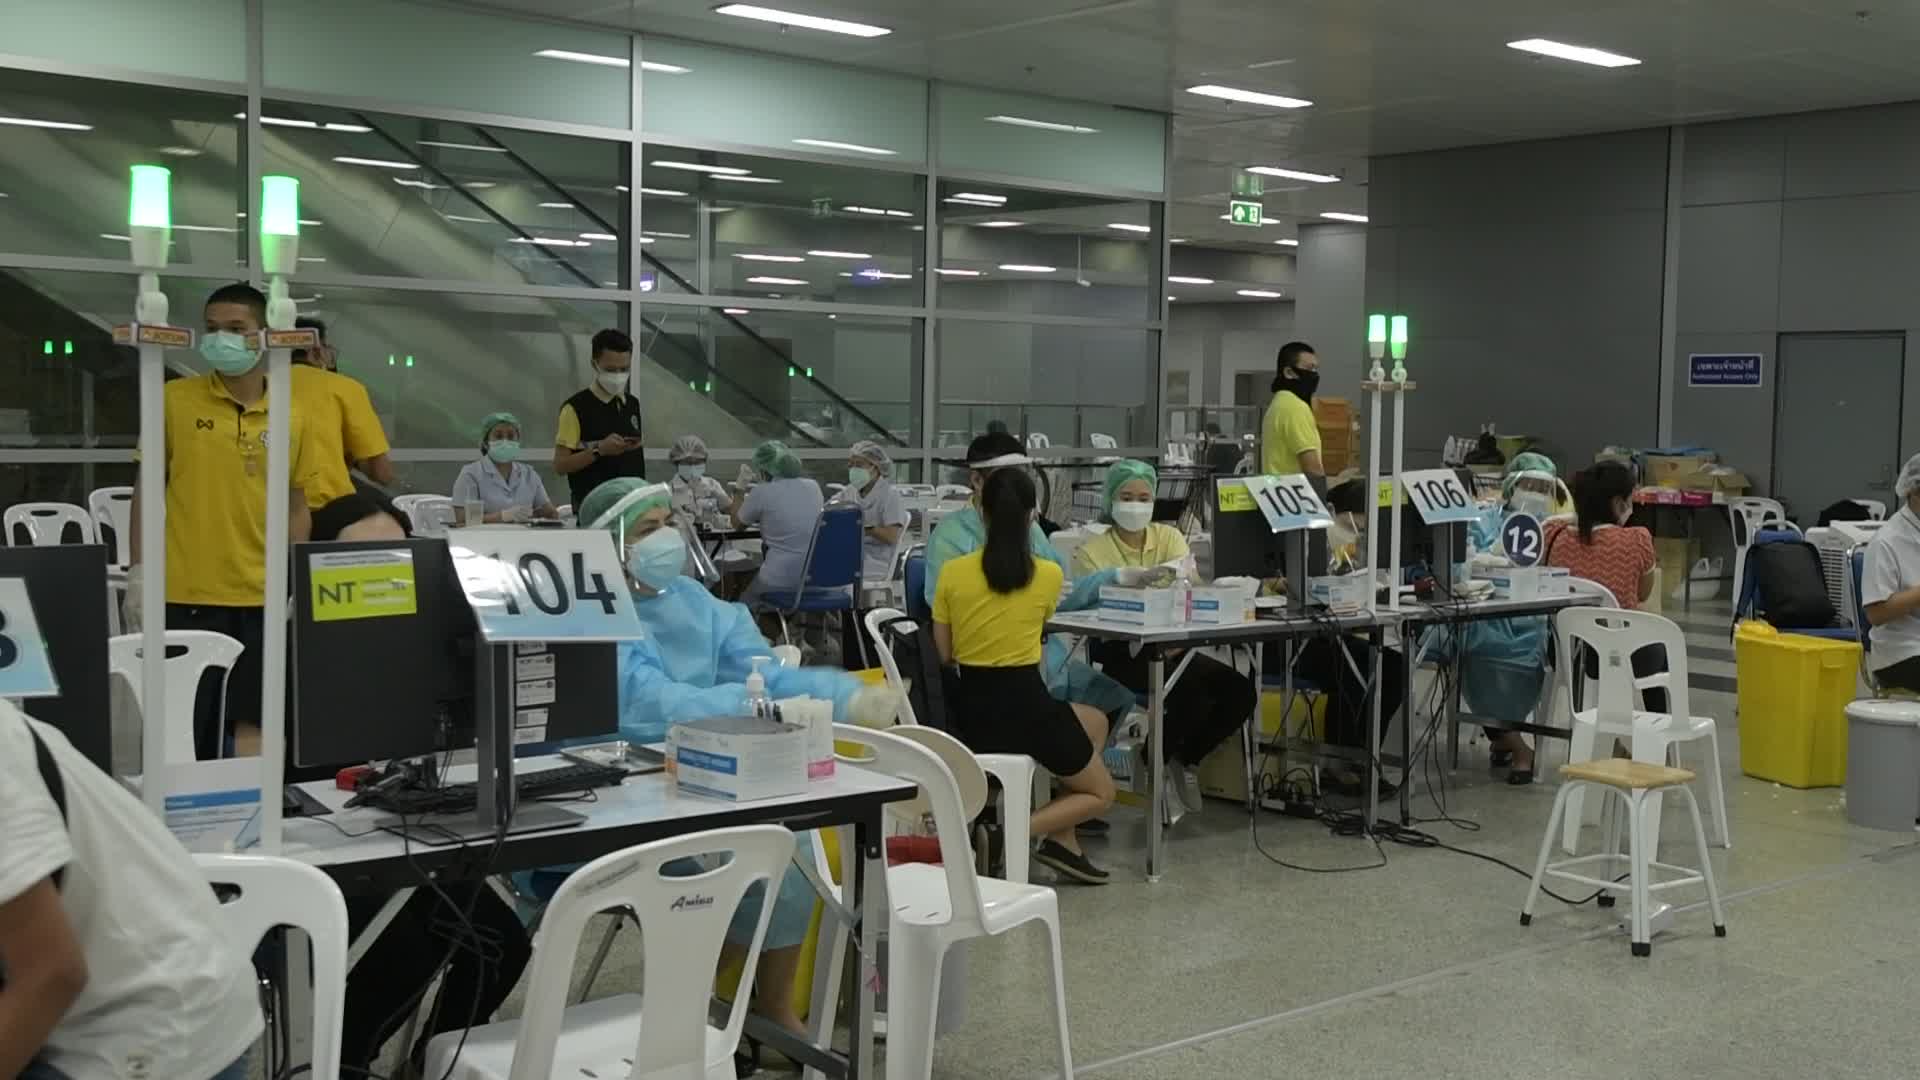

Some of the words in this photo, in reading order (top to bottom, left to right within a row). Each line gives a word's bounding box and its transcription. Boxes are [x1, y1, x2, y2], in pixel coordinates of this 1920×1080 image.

[1220, 492, 1236, 505] NT
[1259, 485, 1318, 517] 105
[1413, 480, 1466, 511] 106
[1508, 525, 1539, 559] 12
[319, 581, 357, 606] NT
